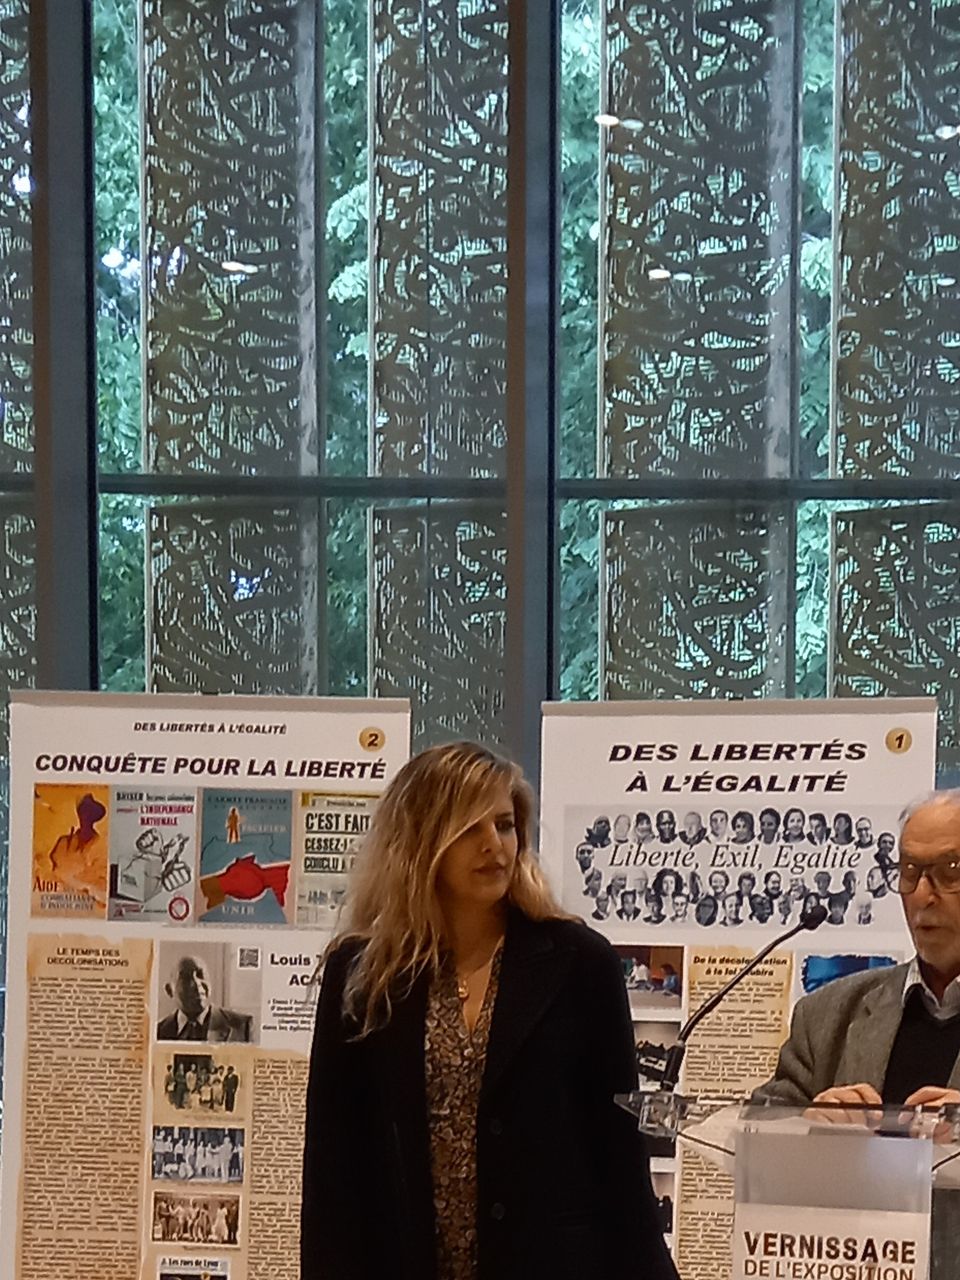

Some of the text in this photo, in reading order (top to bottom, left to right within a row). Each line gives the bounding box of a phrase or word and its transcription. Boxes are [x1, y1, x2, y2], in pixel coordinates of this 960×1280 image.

[134, 722, 156, 732] DES
[160, 722, 214, 733] LIBERTÉS
[367, 733, 379, 747] 2
[894, 734, 905, 749] 1
[609, 739, 867, 762] DES LIBERTÉS
[35, 752, 386, 780] CONQUÊTE POUR LA LIBERTÉ
[625, 770, 848, 793] À L'ÉGALITÉ
[306, 813, 370, 831] C'EST FAIT
[608, 843, 701, 869] Liberté,
[710, 845, 763, 870] Exil,
[270, 953, 311, 966] Louis
[744, 1231, 916, 1264] VERNISSAGE
[744, 1259, 770, 1278] DE
